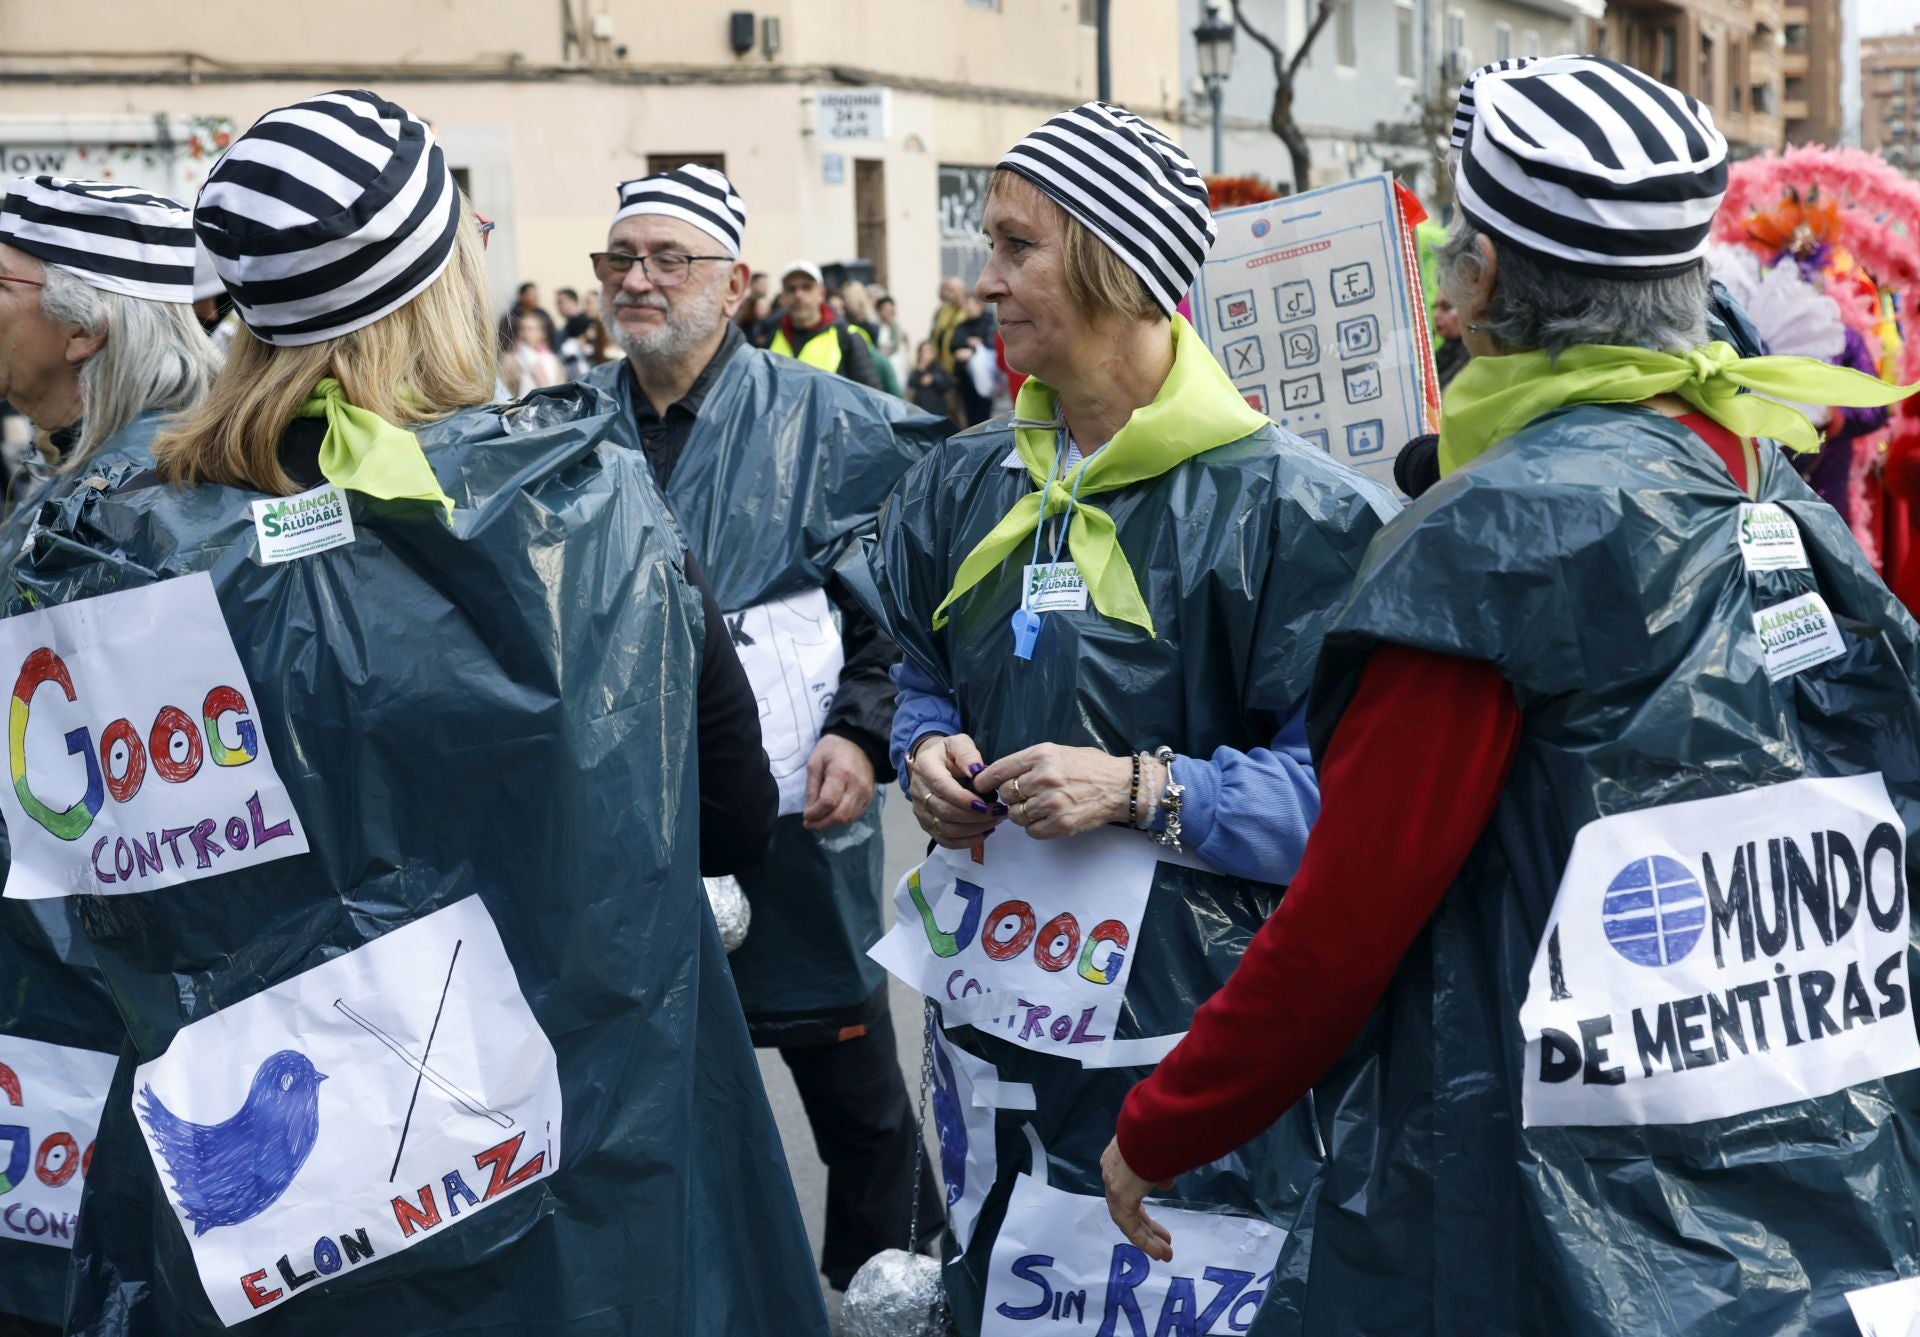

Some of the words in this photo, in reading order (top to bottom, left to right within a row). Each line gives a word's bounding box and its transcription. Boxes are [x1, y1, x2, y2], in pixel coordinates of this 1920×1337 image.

[262, 506, 343, 537] SALUDABLE
[92, 790, 294, 883] CONTROL
[1702, 822, 1904, 969] MUNDO
[1539, 1014, 1627, 1086] DE
[240, 1227, 376, 1310] ELON
